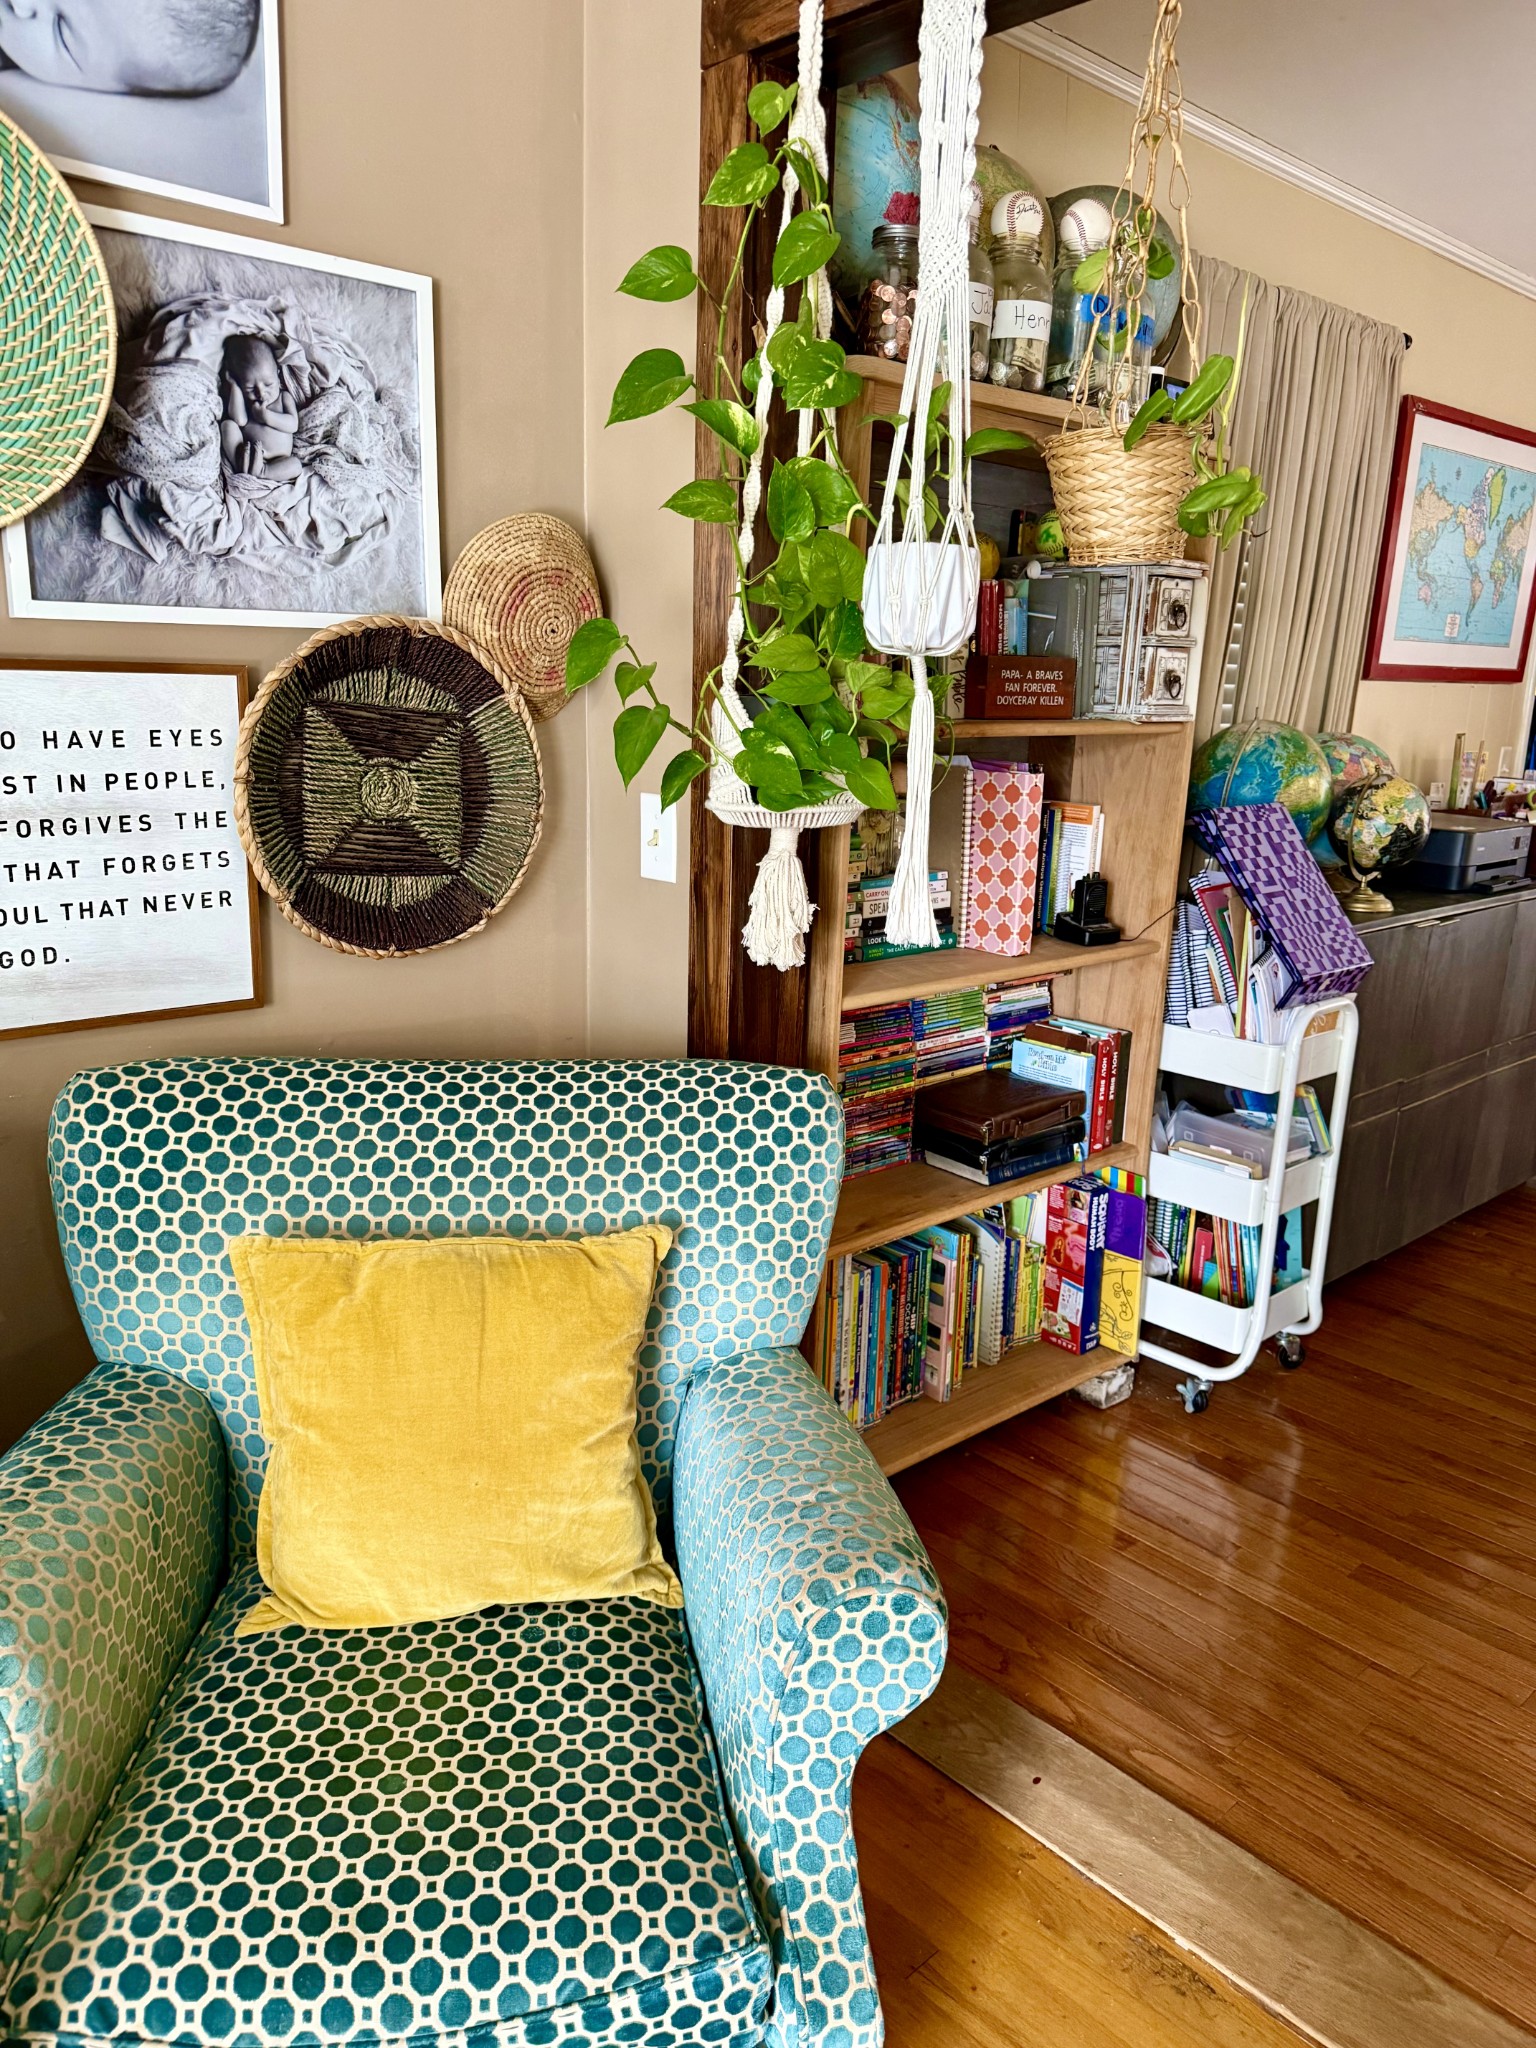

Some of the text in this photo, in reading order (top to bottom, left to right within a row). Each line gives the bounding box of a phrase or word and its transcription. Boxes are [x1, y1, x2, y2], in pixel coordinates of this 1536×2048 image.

[1001, 669, 1064, 680] PAPA- A BRAVES
[1005, 683, 1057, 692] FAN FOREVER.
[996, 695, 1064, 706] DOYCERAY KILLEN
[42, 729, 127, 750] HAVE
[149, 728, 224, 748] EYES
[2, 770, 226, 795] ST IN PEOPLE,
[174, 810, 228, 831] THE
[3, 850, 231, 883] THAT FORGETS
[60, 897, 129, 921] THAT
[142, 890, 233, 915] NEVER
[865, 890, 881, 898] CARRY
[867, 937, 881, 945] LOOK
[0, 946, 71, 970] GOD.
[1089, 1196, 1098, 1251] HUMAN BODY
[1096, 1192, 1109, 1250] SQUISHY
[904, 1303, 912, 1338] OCEANS
